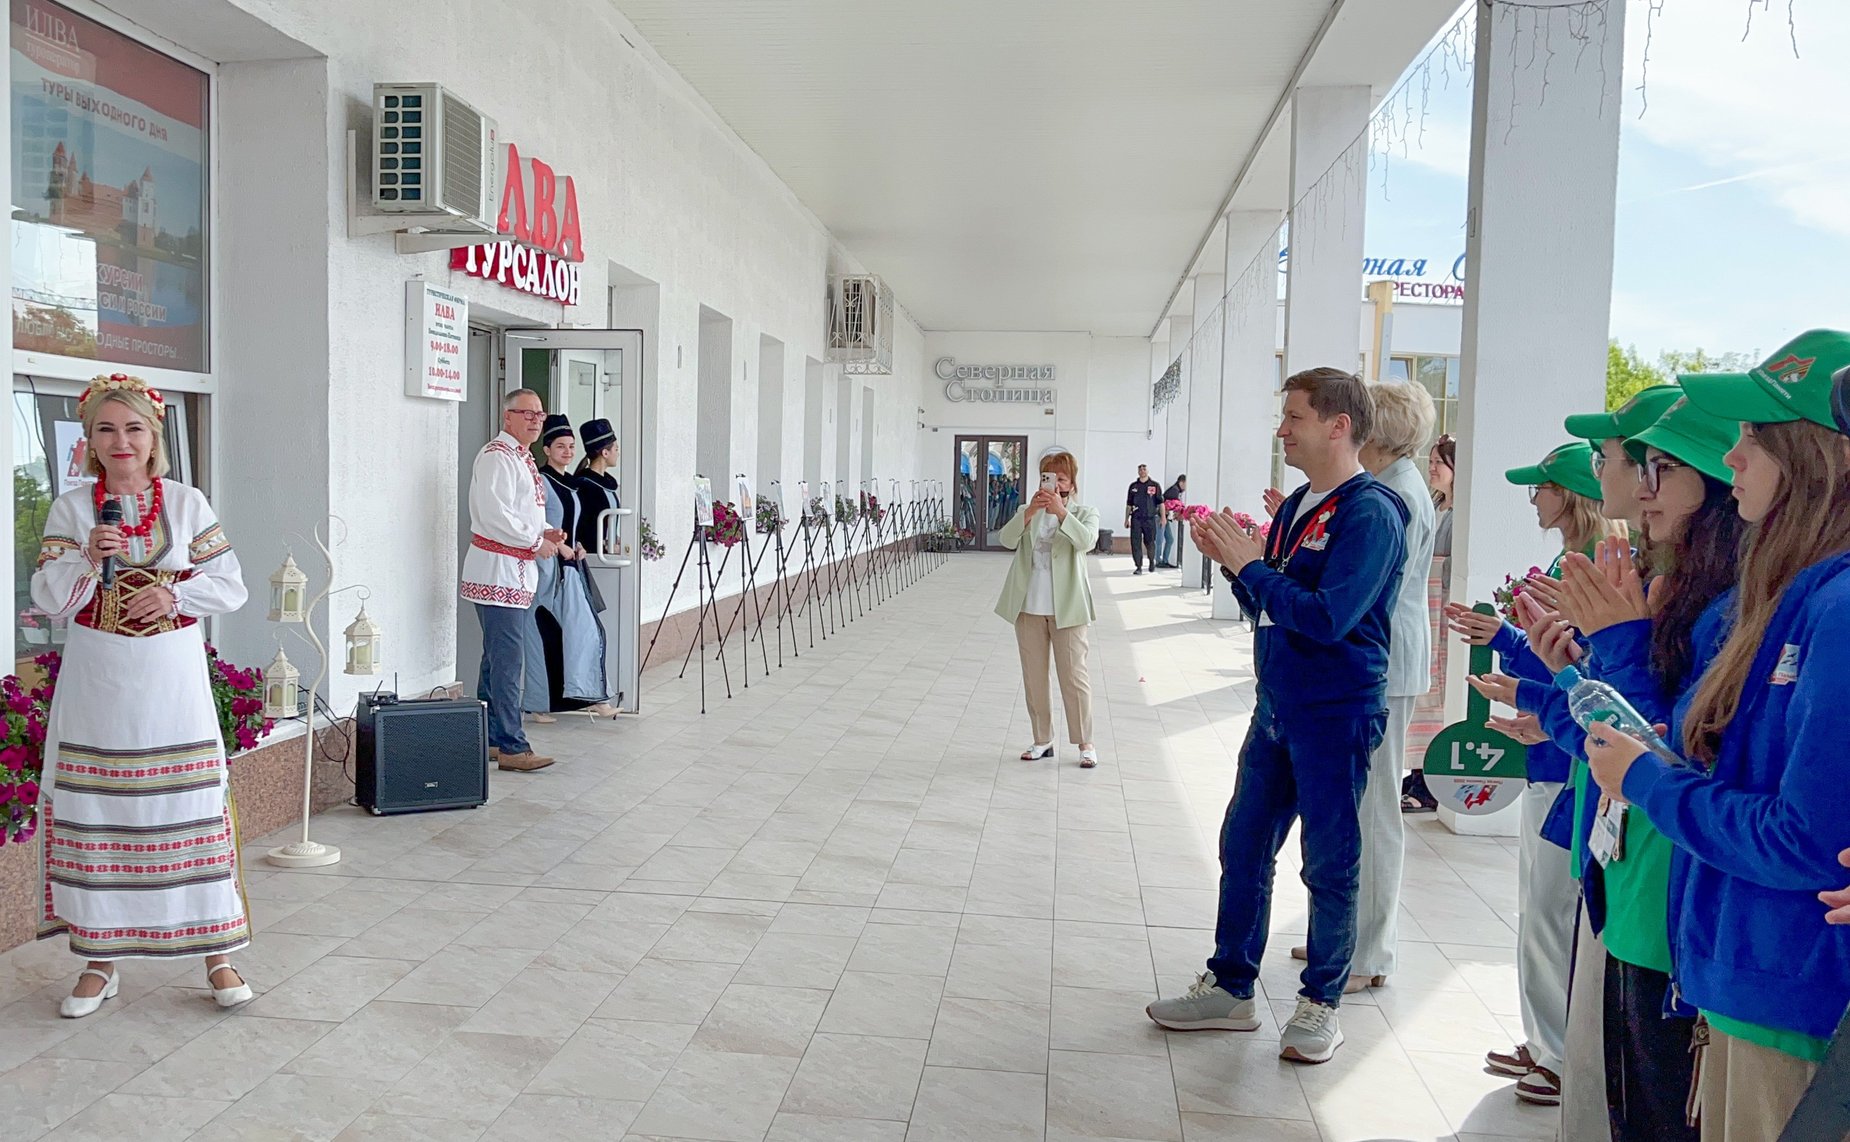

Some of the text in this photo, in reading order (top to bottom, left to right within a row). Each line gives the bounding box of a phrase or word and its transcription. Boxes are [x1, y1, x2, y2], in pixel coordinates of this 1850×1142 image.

[41, 77, 168, 142] ТУРЫ ВЫХОДНОГО ДНЯ
[497, 143, 584, 262] ЛВА
[465, 241, 581, 306] ТУРСАЛОН
[1392, 281, 1465, 300] РЕСТОРА
[935, 357, 1056, 387] Северная
[946, 380, 1054, 405] Столица
